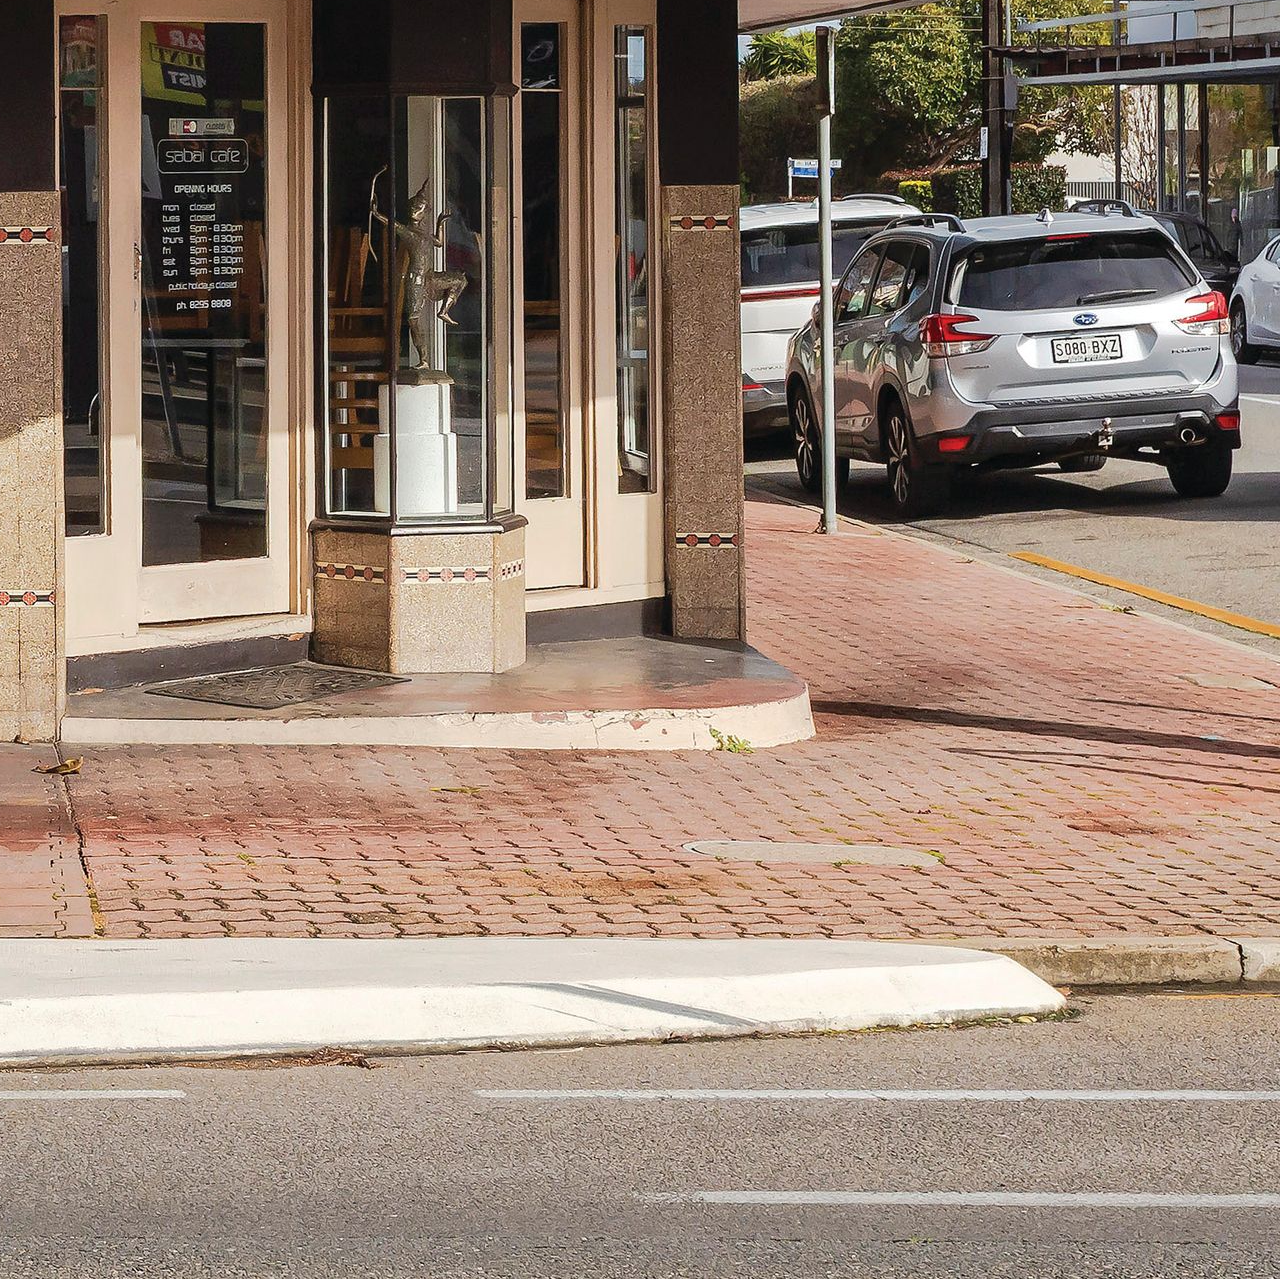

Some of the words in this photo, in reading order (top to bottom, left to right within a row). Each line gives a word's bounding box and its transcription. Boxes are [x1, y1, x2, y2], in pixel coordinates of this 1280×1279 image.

[165, 147, 204, 163] sabai
[174, 185, 205, 193] OPENING
[207, 184, 232, 193] HOURS
[190, 203, 215, 211] closed
[189, 224, 207, 234] 5pm
[162, 236, 184, 244] thurs
[189, 235, 207, 244] 5pm
[162, 246, 171, 254] fri
[189, 246, 207, 255] 5pm
[189, 256, 207, 266] 5pm
[189, 267, 207, 277] 5pm
[216, 281, 237, 289] closed
